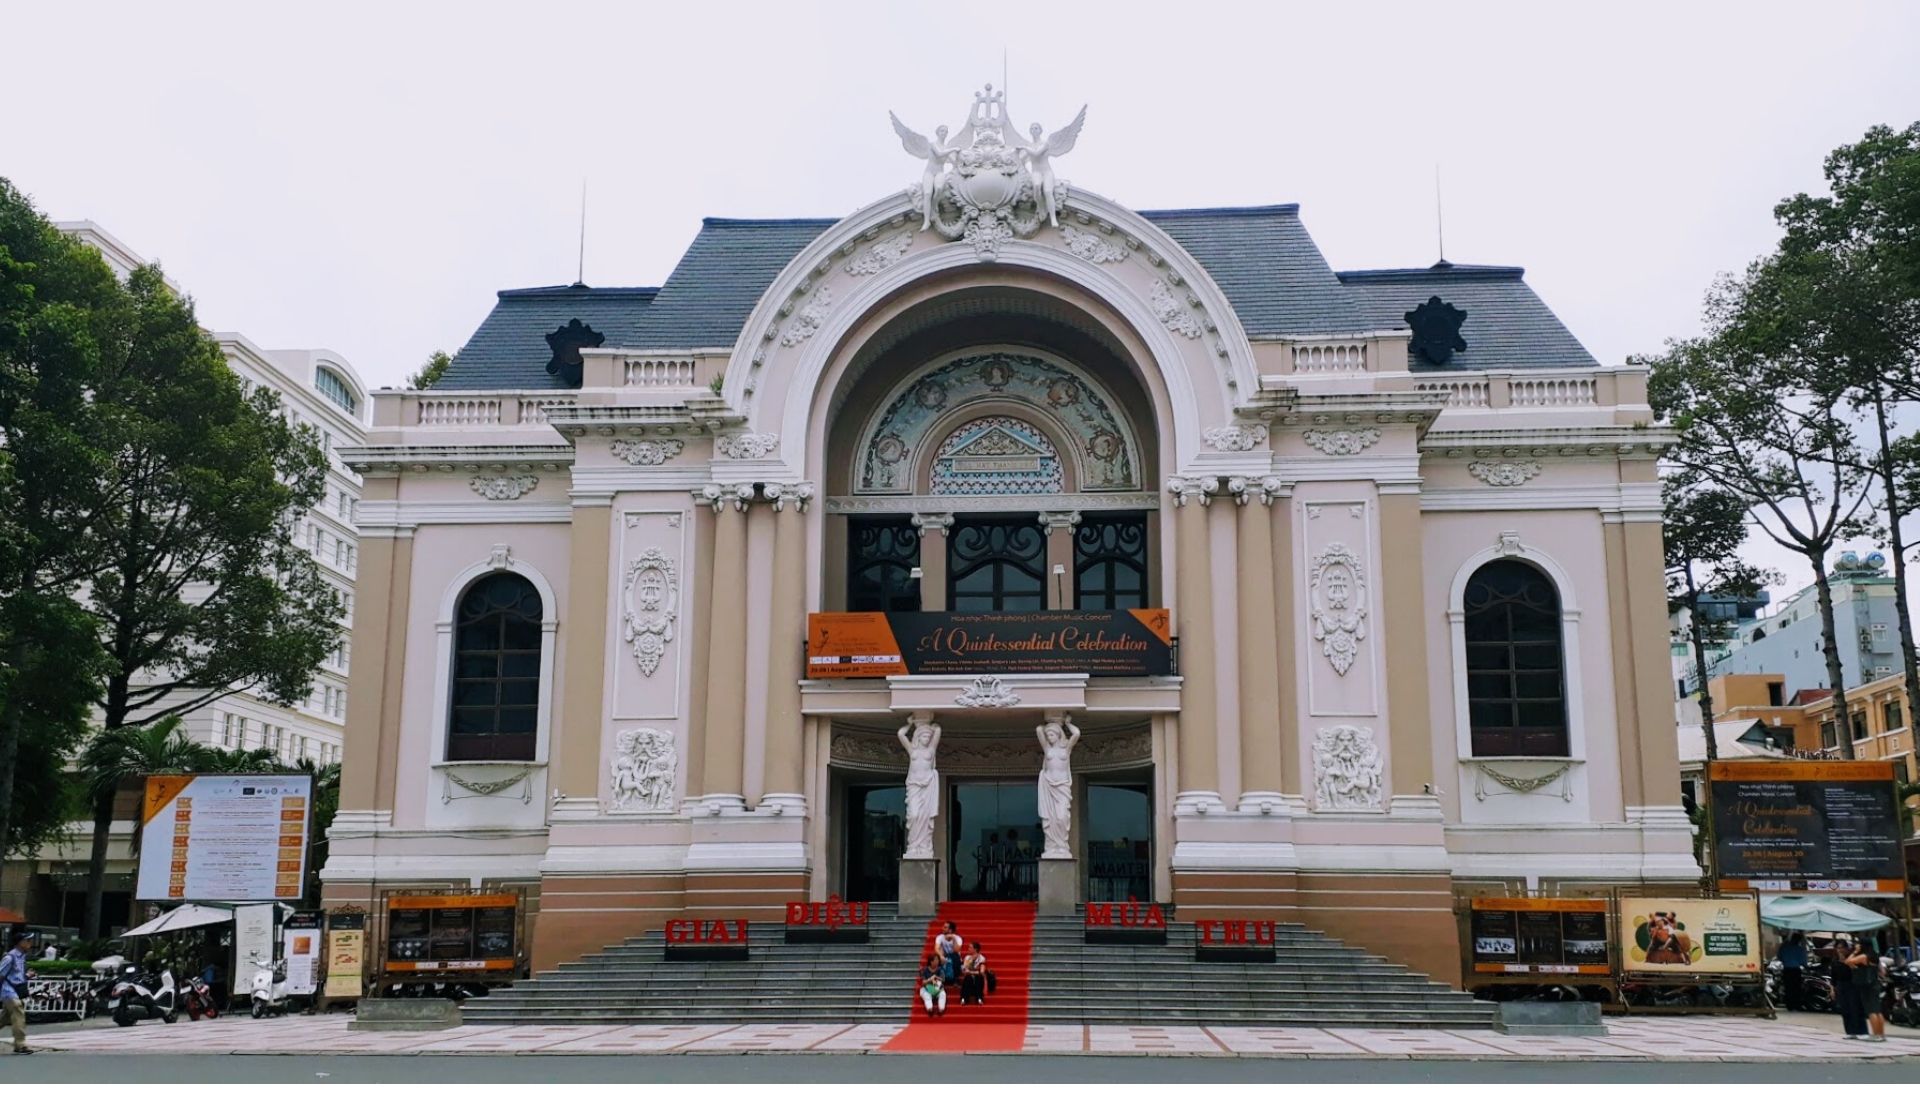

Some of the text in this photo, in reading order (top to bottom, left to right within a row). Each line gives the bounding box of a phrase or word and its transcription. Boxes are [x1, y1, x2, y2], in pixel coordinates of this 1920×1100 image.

[1084, 613, 1112, 621] Concert
[917, 626, 1148, 656] A Quintessential Celebration
[665, 893, 1276, 945] GIAI ĐIỆU MÙA THU
